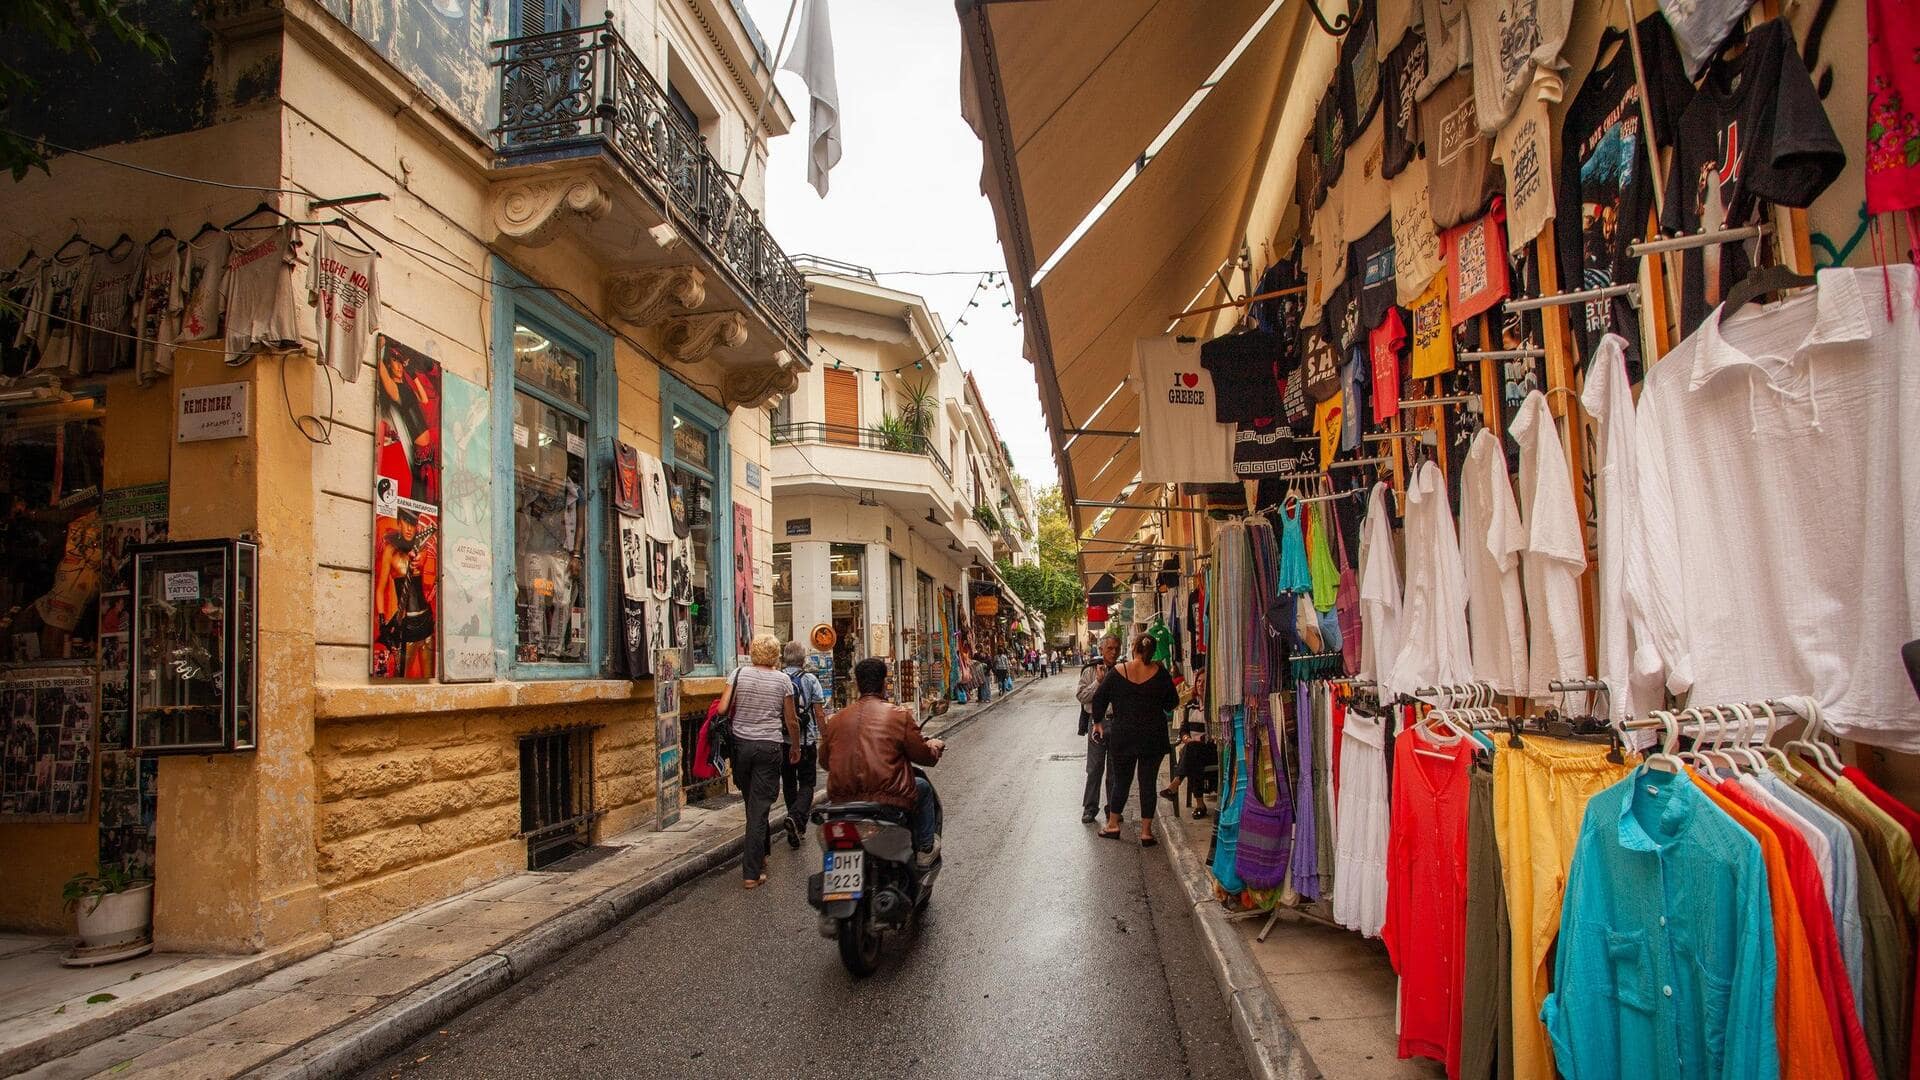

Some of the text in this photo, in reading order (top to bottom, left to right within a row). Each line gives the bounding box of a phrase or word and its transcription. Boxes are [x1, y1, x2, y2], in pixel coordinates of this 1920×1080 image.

[1174, 372, 1182, 387] I
[183, 395, 232, 415] REMEMBER
[1168, 389, 1205, 405] GREECE
[168, 586, 198, 594] TATTOO
[833, 873, 861, 890] 223
